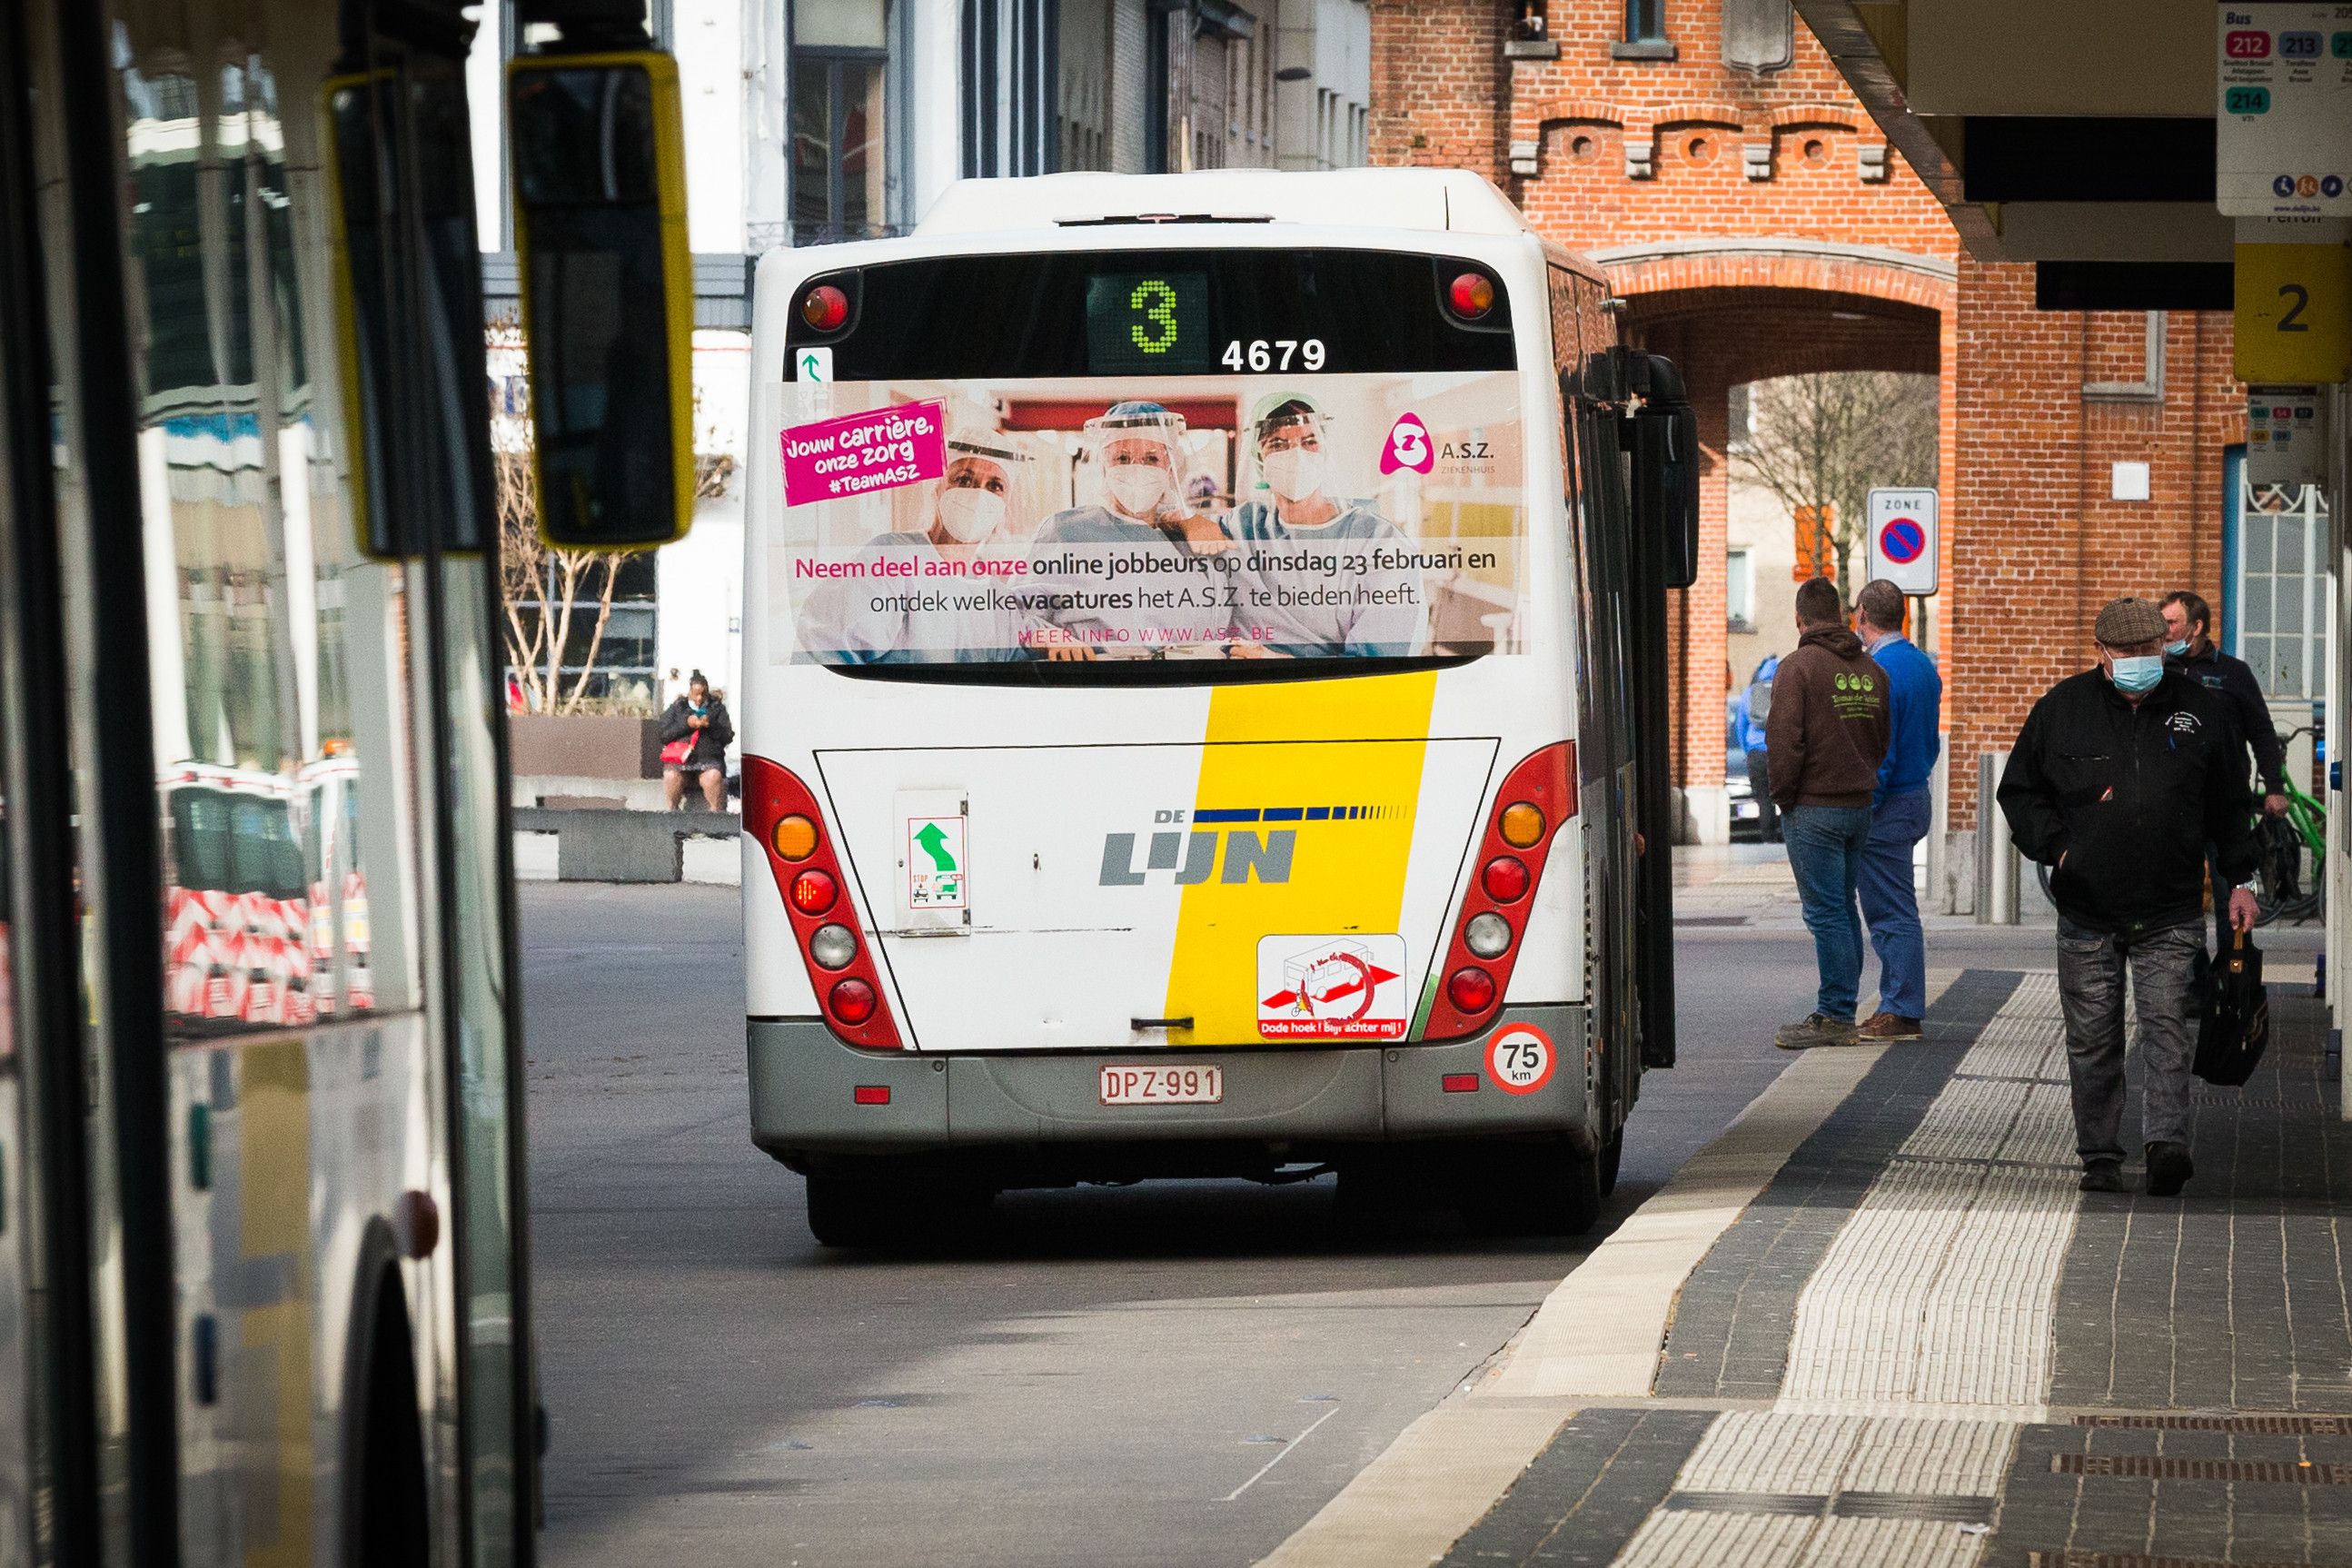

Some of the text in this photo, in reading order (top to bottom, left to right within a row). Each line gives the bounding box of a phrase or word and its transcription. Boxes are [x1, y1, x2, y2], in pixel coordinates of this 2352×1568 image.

[2226, 12, 2252, 25] Bus
[2232, 37, 2264, 54] 212
[2285, 37, 2316, 54] 213
[2231, 93, 2264, 109] 214
[1130, 280, 1177, 353] 3
[2277, 283, 2309, 332] 2
[1221, 339, 1326, 372] 4679
[787, 415, 934, 459] Jouw carrière,
[814, 440, 915, 474] onze zorg
[1441, 442, 1494, 460] A.S.Z.
[829, 463, 920, 494] #TeamASZ
[1441, 465, 1495, 474] ZIEKENHUIS
[1885, 500, 1920, 510] ZONE
[796, 547, 1496, 581] Neem deel aan onze online jobbeurs op dinsdag 23 februari en
[870, 583, 1421, 612] ontdek welke vacatures het A.S.Z. te bieden heeft.
[1017, 628, 1072, 645] MEER
[1082, 628, 1129, 642] INFO
[1154, 809, 1186, 824] DE
[1098, 829, 1297, 886] LIJN
[913, 874, 928, 883] STOP
[1261, 1023, 1288, 1033] Dode
[1345, 1023, 1378, 1033] achter
[1503, 1043, 1540, 1069] 75
[1107, 1069, 1215, 1098] DPZ-991
[1512, 1070, 1532, 1081] km
